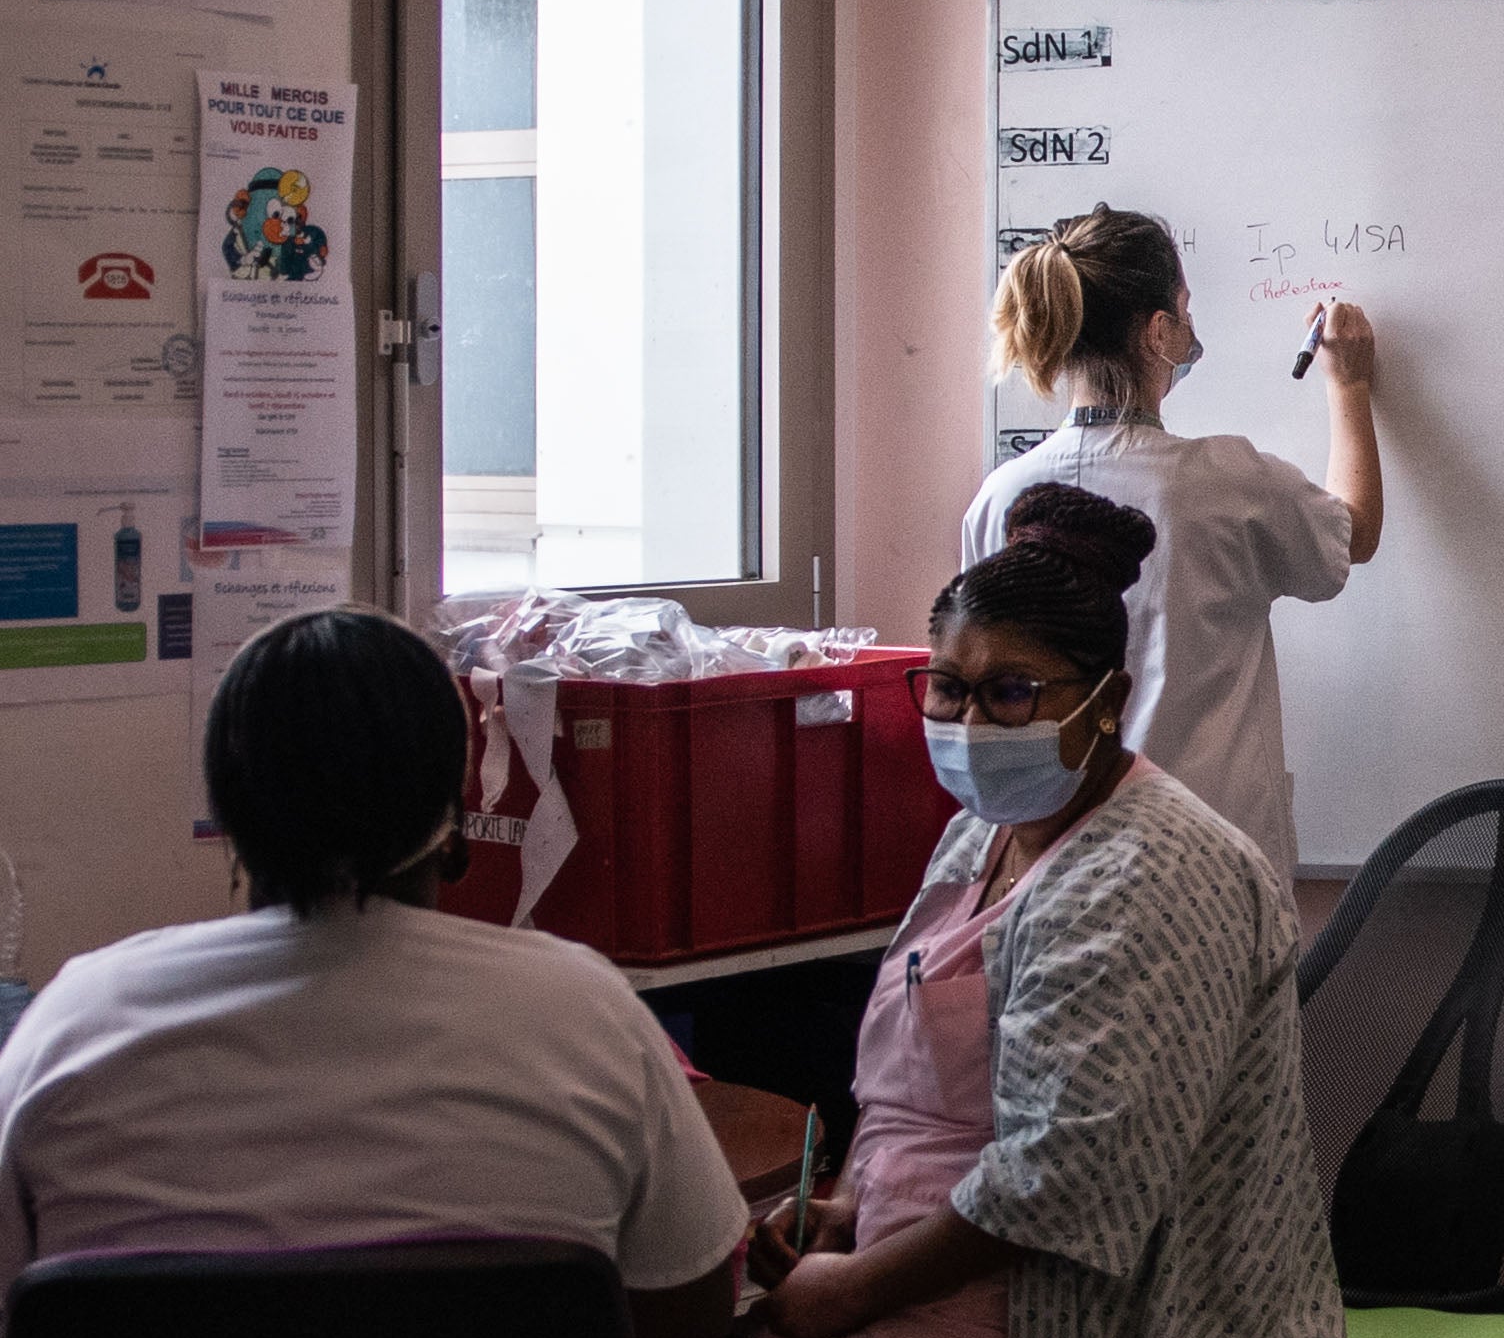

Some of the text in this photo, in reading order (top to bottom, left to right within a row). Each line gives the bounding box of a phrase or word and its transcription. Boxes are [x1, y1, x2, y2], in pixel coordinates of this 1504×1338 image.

[1002, 31, 1068, 65] SdN
[220, 81, 329, 105] MILLE MERCIS
[208, 99, 345, 125] POUR TOUT CE QUE
[230, 119, 319, 141] VOUS FAITES
[1009, 131, 1105, 163] SdN 2
[464, 813, 505, 840] PORTE
